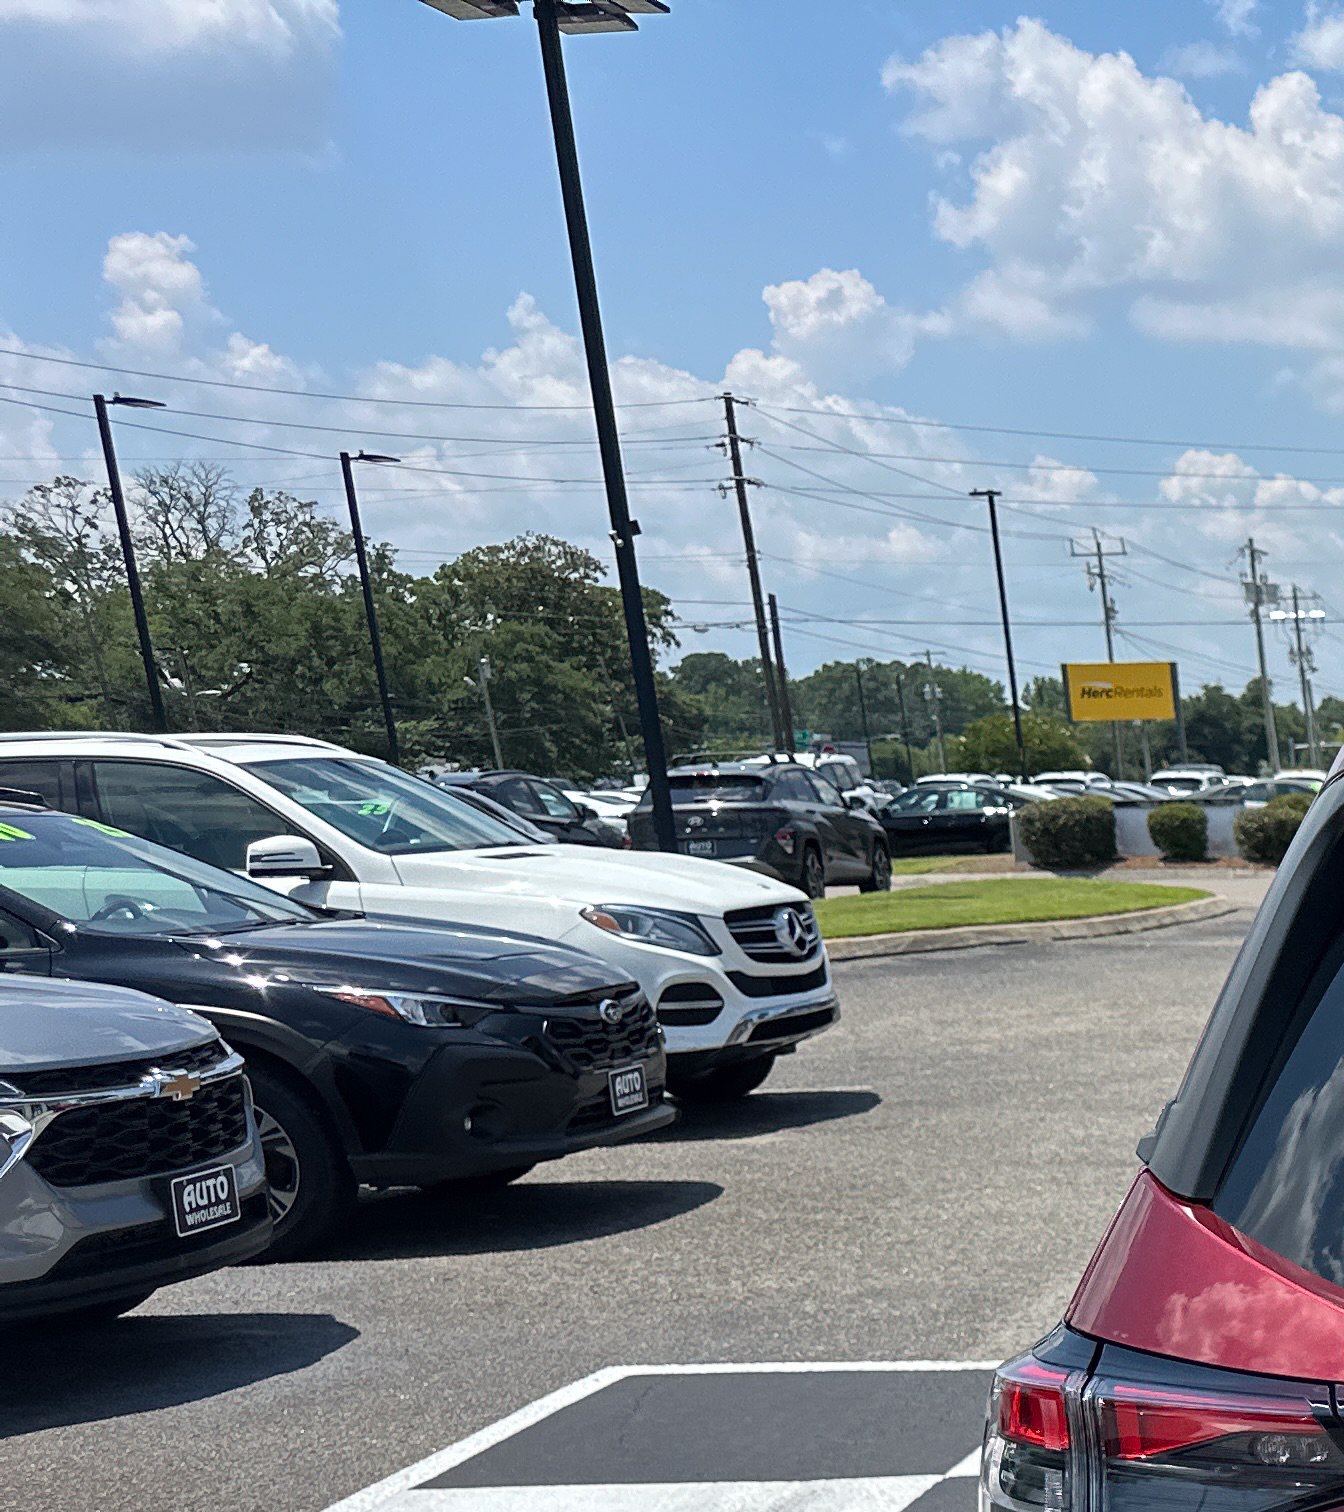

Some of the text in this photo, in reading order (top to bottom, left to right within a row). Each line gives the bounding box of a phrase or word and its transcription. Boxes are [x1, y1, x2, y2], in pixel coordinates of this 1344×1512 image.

[1080, 686, 1163, 699] HercRentals
[615, 1071, 641, 1097] AUTO
[183, 1175, 228, 1213] AUTO
[185, 1201, 232, 1226] WHOLESALE
